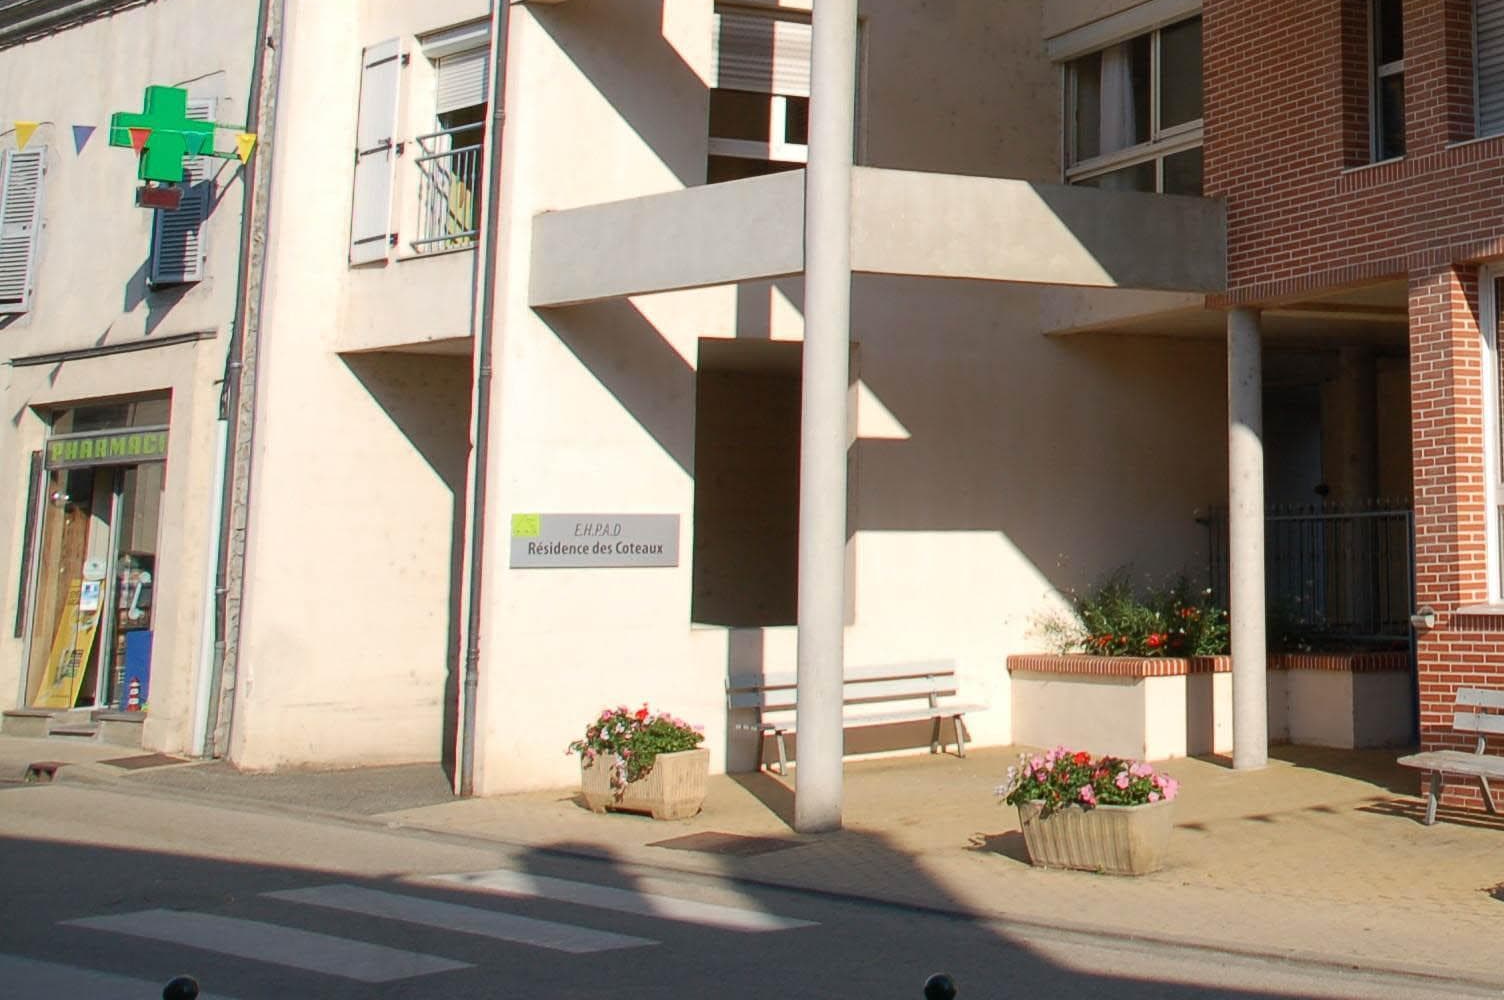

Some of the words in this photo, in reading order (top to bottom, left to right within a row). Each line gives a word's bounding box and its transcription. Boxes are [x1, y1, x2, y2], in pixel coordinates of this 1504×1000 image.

[528, 541, 589, 556] Résidence
[592, 541, 613, 555] des
[615, 541, 663, 555] Coteaux
